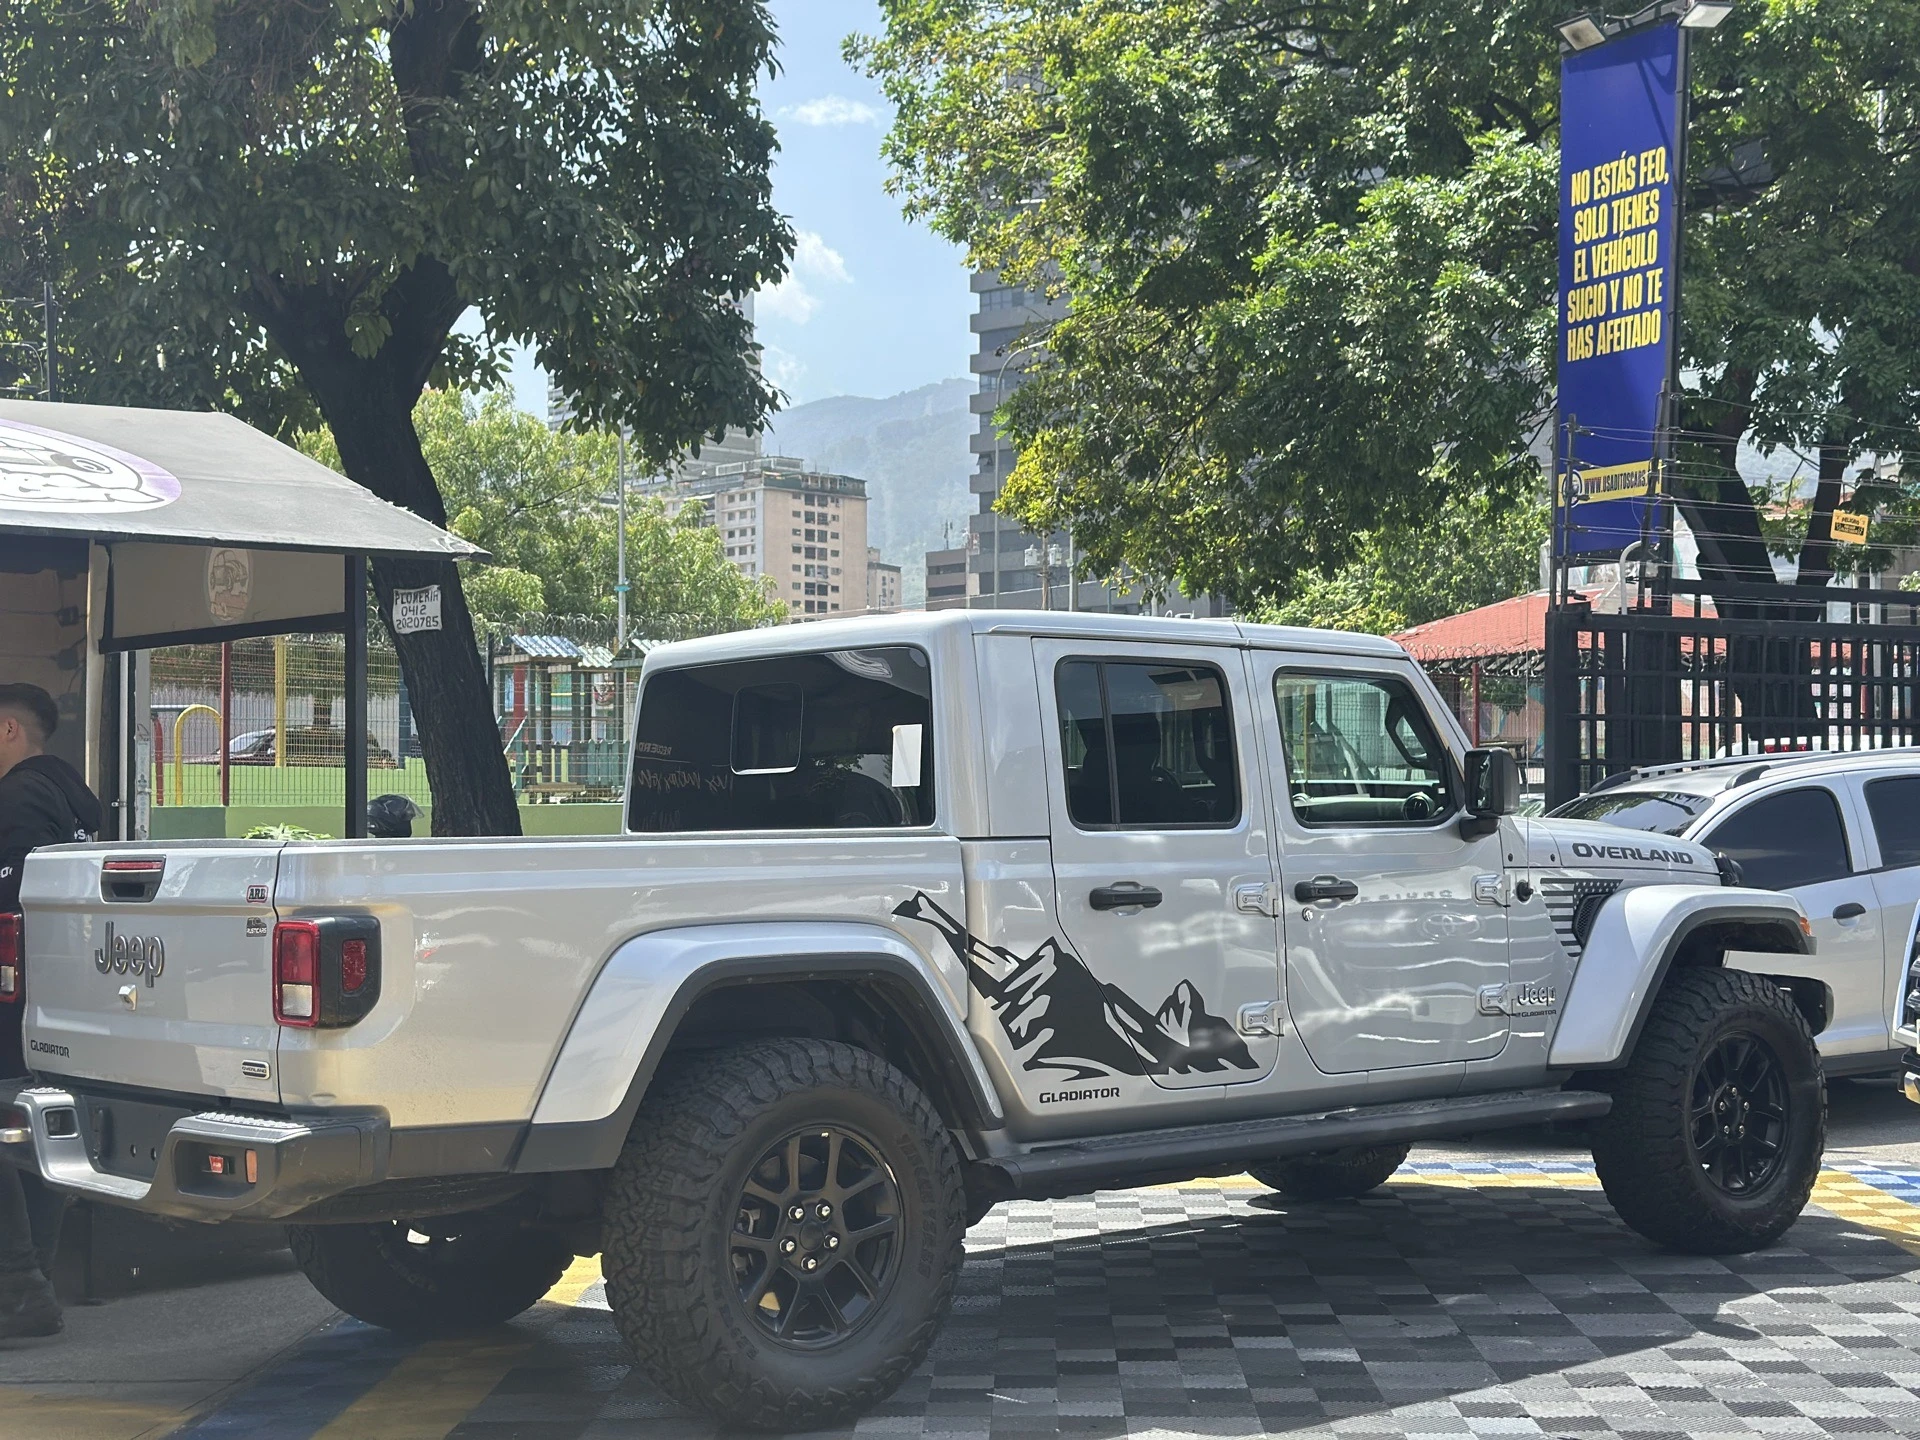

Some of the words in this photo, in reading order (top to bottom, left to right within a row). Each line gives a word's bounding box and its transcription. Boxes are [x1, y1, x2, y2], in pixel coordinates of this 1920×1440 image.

[1571, 169, 1590, 207] NO
[1593, 150, 1636, 200] ESTÁS
[1639, 146, 1669, 185] FEO,
[1574, 203, 1608, 245] SOLO
[1612, 188, 1660, 234] TIENES
[1574, 248, 1588, 283] EL
[1592, 229, 1658, 279] VEHÍCULO
[1567, 282, 1607, 324] SUCIO
[1610, 279, 1620, 313] Y
[1623, 273, 1643, 311] NO
[1646, 267, 1663, 305] TE
[1567, 324, 1594, 362] HAS
[1596, 309, 1661, 356] AFEITADO
[395, 590, 439, 605] PLOMERIA
[401, 604, 427, 617] 0412
[396, 615, 439, 630] 2020785
[1572, 842, 1693, 864] OVERLAND
[249, 888, 266, 900] ARB
[95, 921, 164, 988] Jeep
[1517, 984, 1556, 1007] Jeep
[1521, 1010, 1557, 1018] GLADIATOR
[31, 1039, 70, 1059] GLADIATOR
[1039, 1087, 1120, 1104] GLADIATOR
